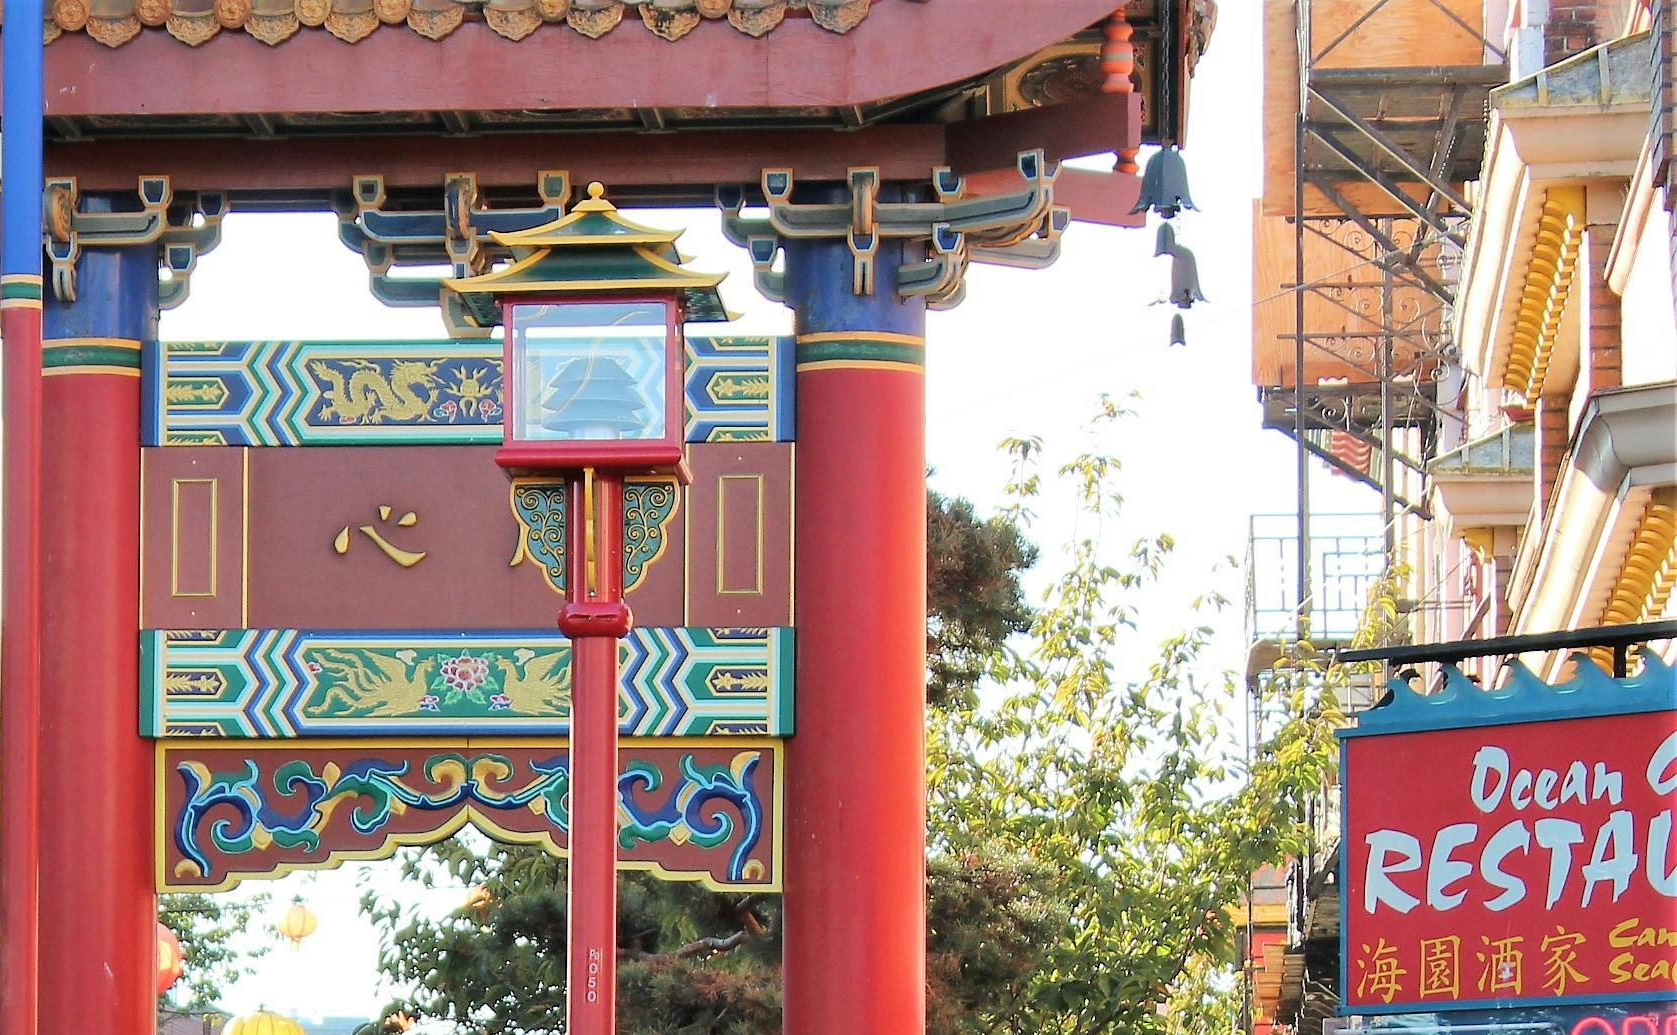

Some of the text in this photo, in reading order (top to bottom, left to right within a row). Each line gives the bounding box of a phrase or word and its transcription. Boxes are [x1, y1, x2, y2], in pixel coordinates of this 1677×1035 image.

[1470, 745, 1624, 814] Ocean
[1357, 926, 1591, 1005] 海園酒家
